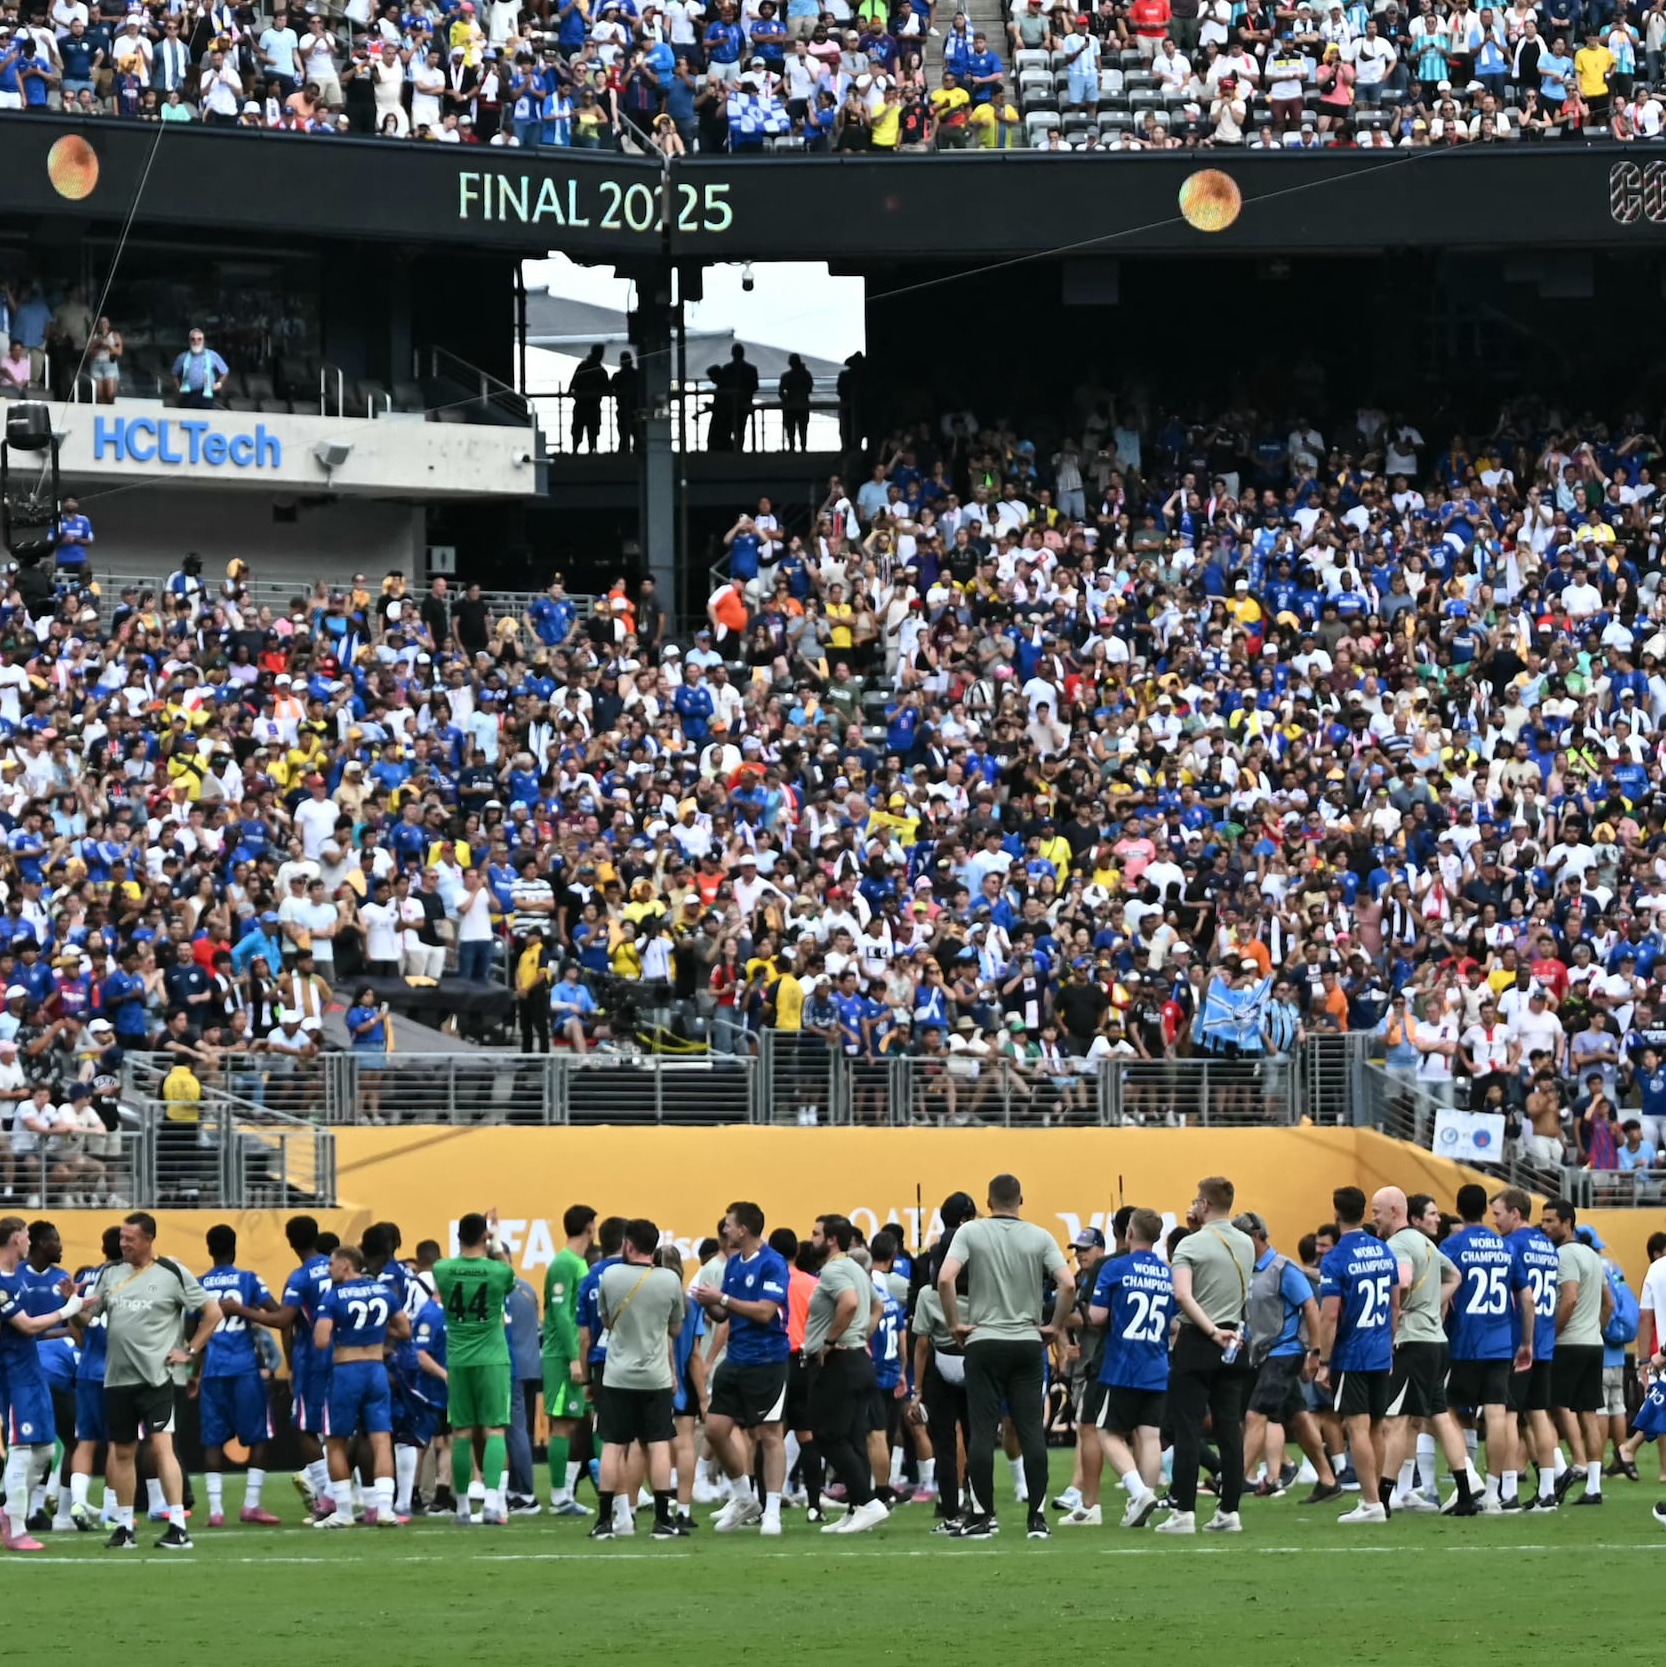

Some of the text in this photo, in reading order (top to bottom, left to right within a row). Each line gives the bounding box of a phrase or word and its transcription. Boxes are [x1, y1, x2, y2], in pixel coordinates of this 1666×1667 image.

[458, 172, 590, 227] FINAL
[93, 415, 283, 469] HCLTech
[847, 1207, 946, 1257] QATA
[1352, 1244, 1384, 1259] WORLD
[1469, 1236, 1505, 1250] WORLD
[1528, 1238, 1555, 1254] WORLD
[1347, 1257, 1395, 1276] CHAMPIONS
[1460, 1250, 1513, 1266] CHAMPIONS
[1522, 1252, 1559, 1268] CHAMPION
[202, 1272, 241, 1288] GEORGE
[1132, 1261, 1170, 1279] WORLD
[1121, 1274, 1174, 1294] CHAMPION
[1465, 1265, 1510, 1316] 25
[1528, 1267, 1559, 1317] 25
[447, 1280, 490, 1323] 44
[1356, 1275, 1392, 1329] 25
[1121, 1290, 1171, 1344] 25
